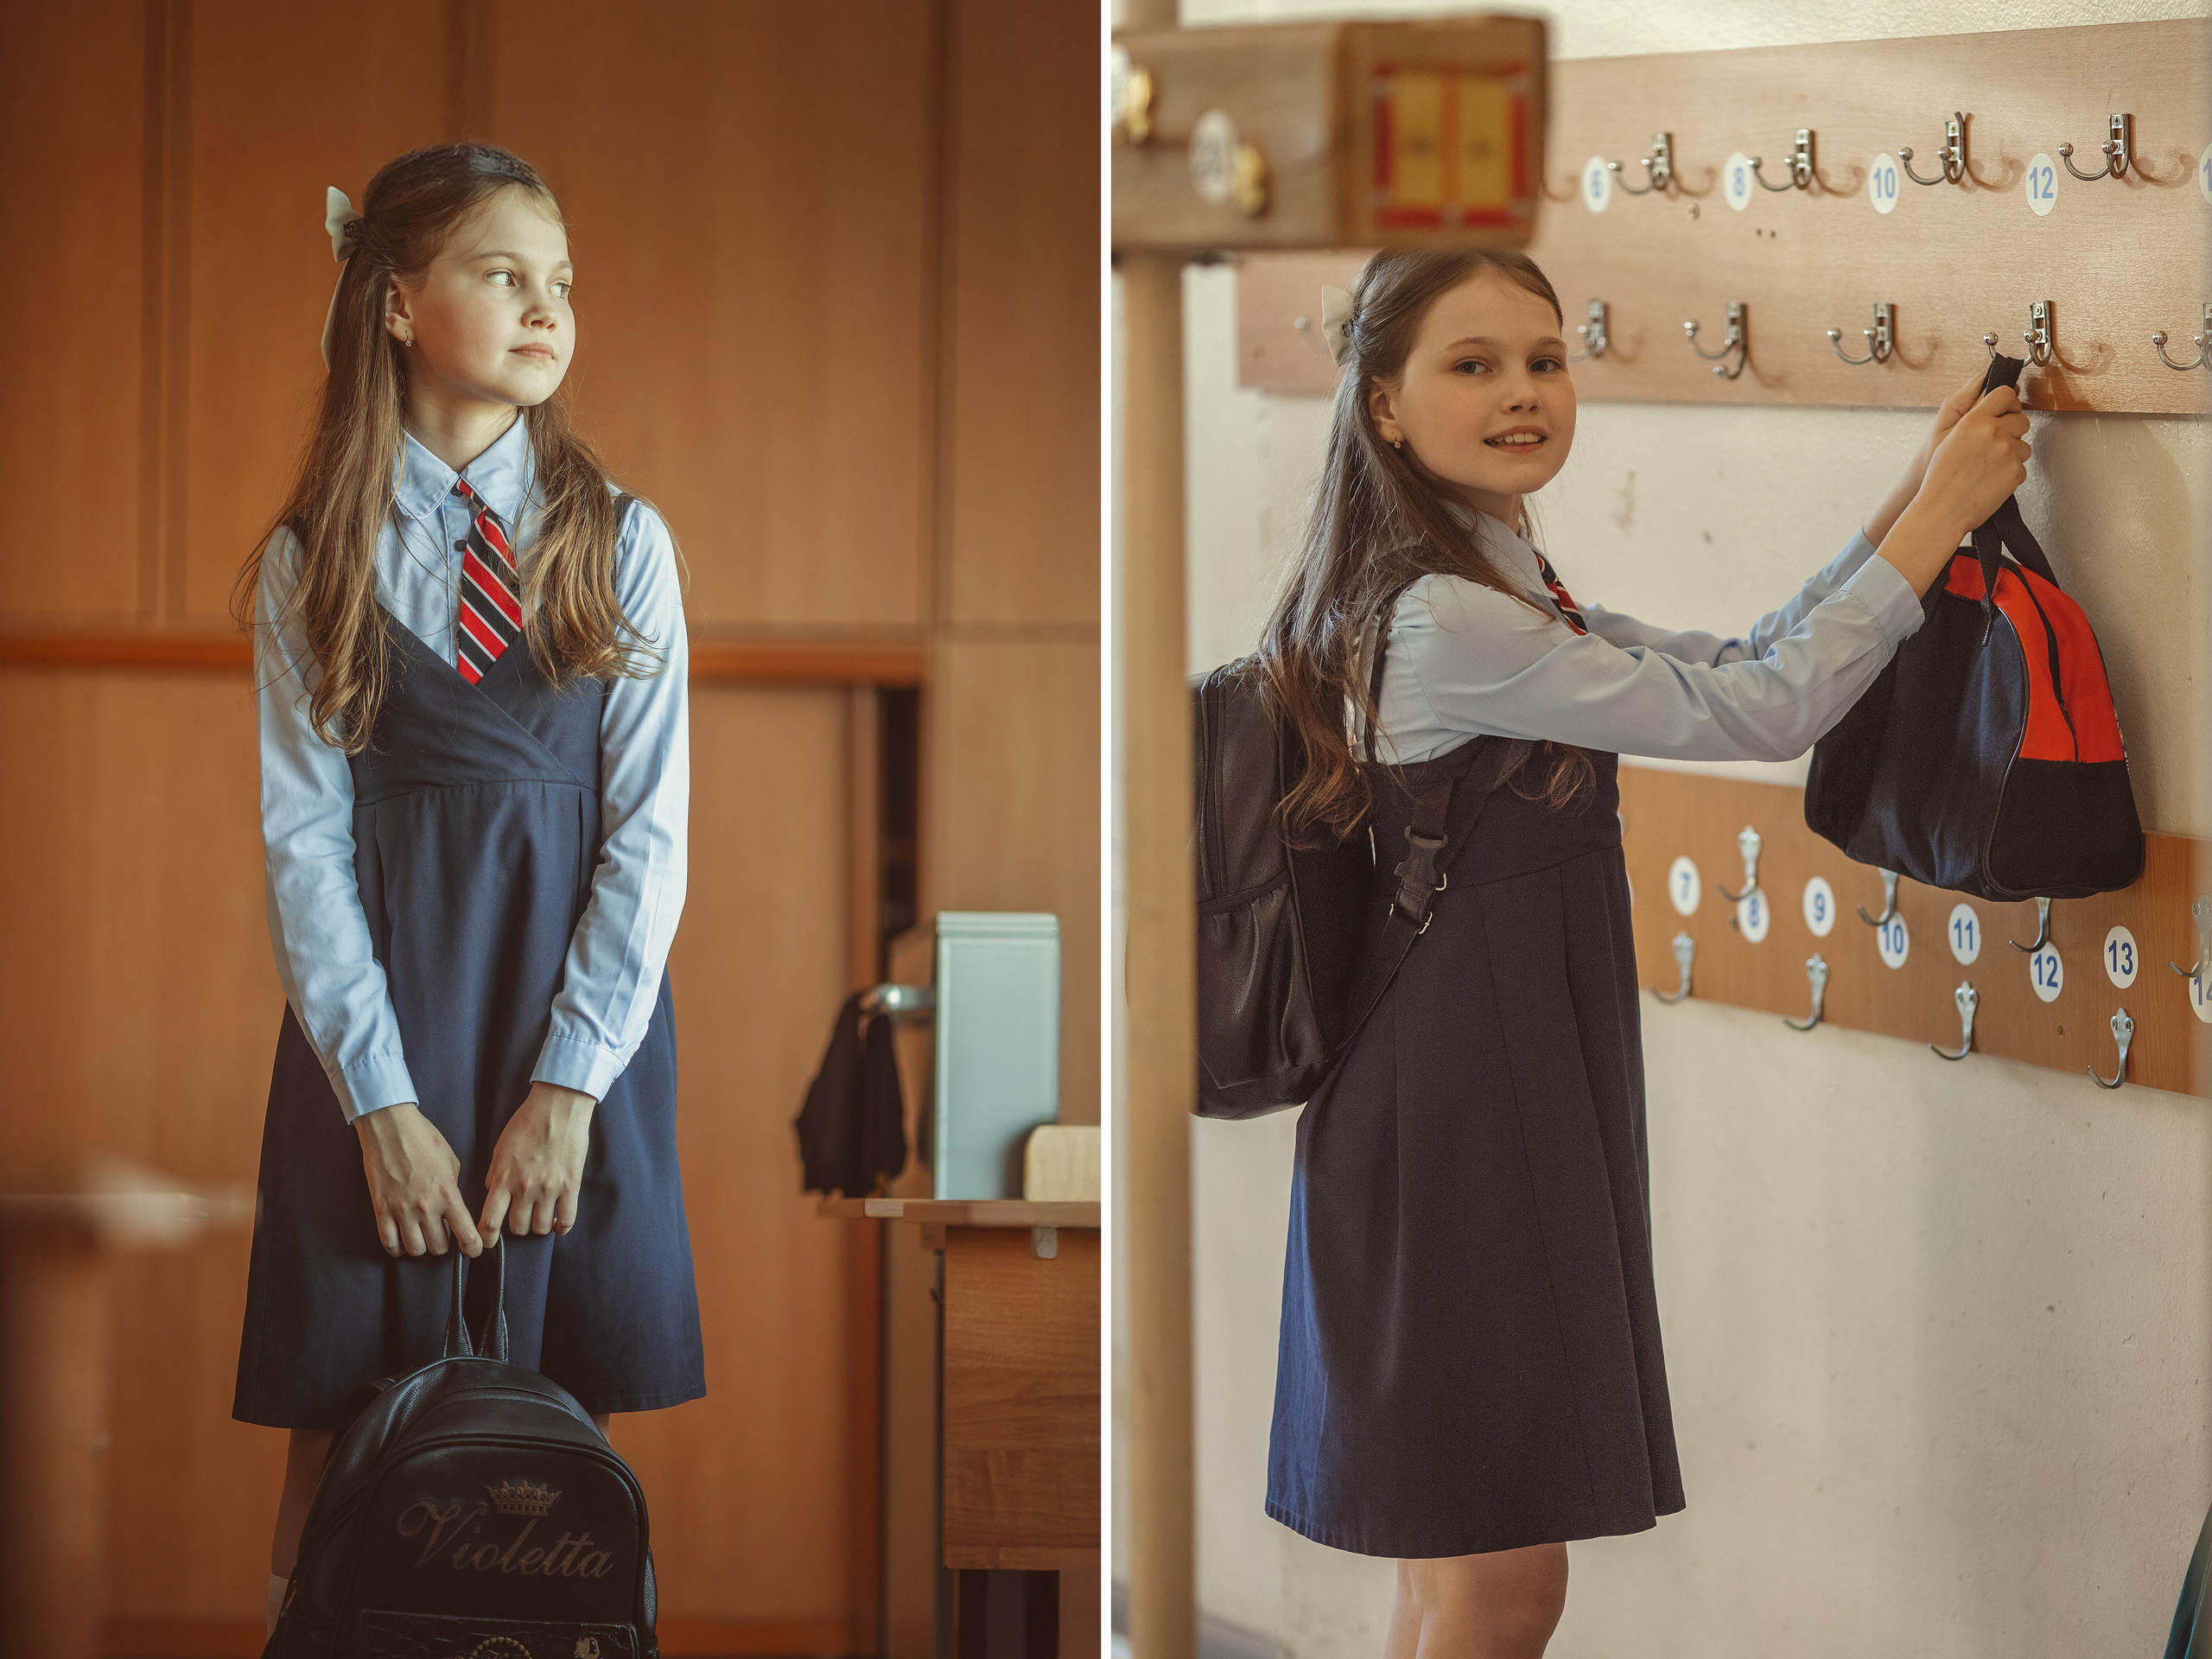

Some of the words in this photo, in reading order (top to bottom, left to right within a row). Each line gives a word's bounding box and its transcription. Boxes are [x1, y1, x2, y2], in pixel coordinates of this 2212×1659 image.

[1733, 166, 1745, 197] 8
[1872, 167, 1896, 199] 10
[2029, 166, 2054, 200] 12
[1681, 871, 1691, 900] 7
[1815, 892, 1825, 922] 9
[1882, 922, 1904, 955] 10
[1954, 918, 1974, 951] 11
[2034, 953, 2058, 988] 12
[2108, 939, 2133, 976] 13
[397, 1501, 614, 1579] Violetta
